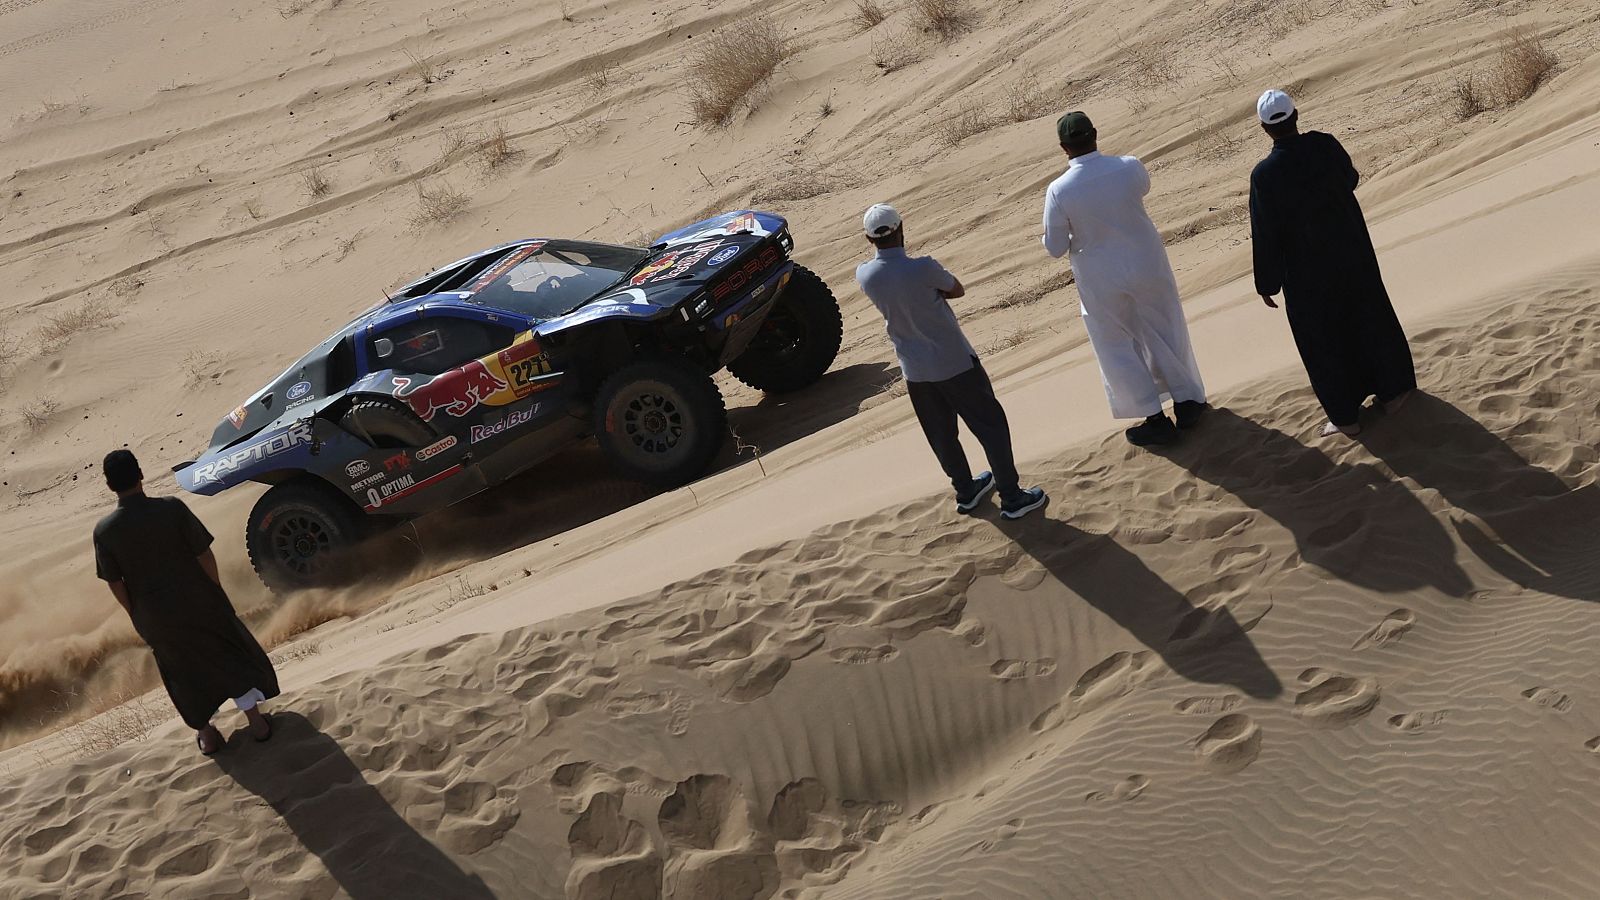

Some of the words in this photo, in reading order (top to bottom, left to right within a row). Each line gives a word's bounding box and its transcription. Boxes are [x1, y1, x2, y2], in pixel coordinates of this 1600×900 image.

[711, 246, 778, 303] FORD
[285, 394, 315, 411] RACING
[470, 418, 507, 444] Red
[506, 402, 541, 429] Bull
[193, 424, 312, 486] RAPTOR
[424, 437, 456, 457] Castrol
[347, 461, 369, 475] BMC
[350, 471, 386, 491] METHOD
[380, 474, 416, 497] OPTIMA
